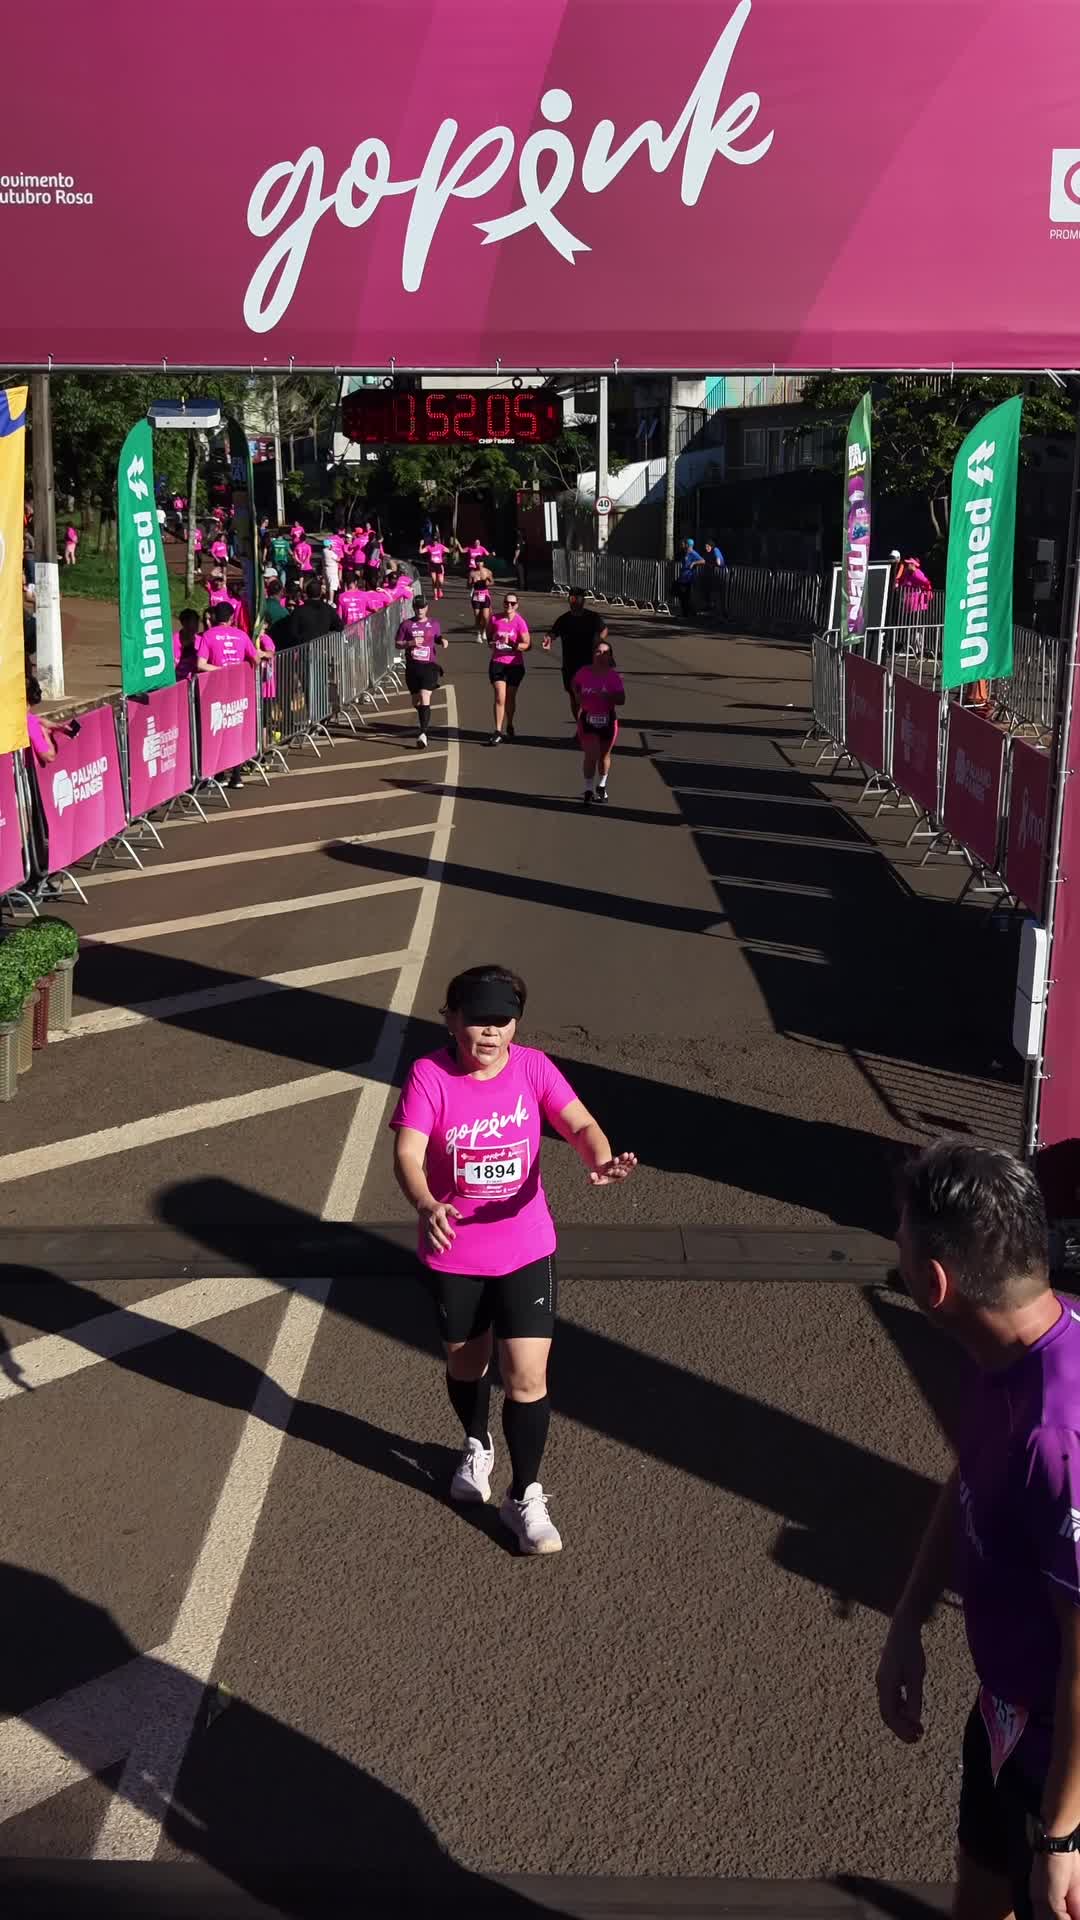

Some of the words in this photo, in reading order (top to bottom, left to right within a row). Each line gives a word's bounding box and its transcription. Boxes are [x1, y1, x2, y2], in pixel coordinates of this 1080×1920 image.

[0, 172, 74, 188] ovimento
[243, 0, 775, 333] gopink
[0, 189, 51, 204] utubro
[55, 189, 94, 204] Rosa
[1049, 229, 1080, 240] PROM
[133, 511, 166, 677] Unimed
[960, 497, 993, 668] Unimed
[445, 1094, 529, 1154] gopink
[474, 1162, 515, 1178] 1894
